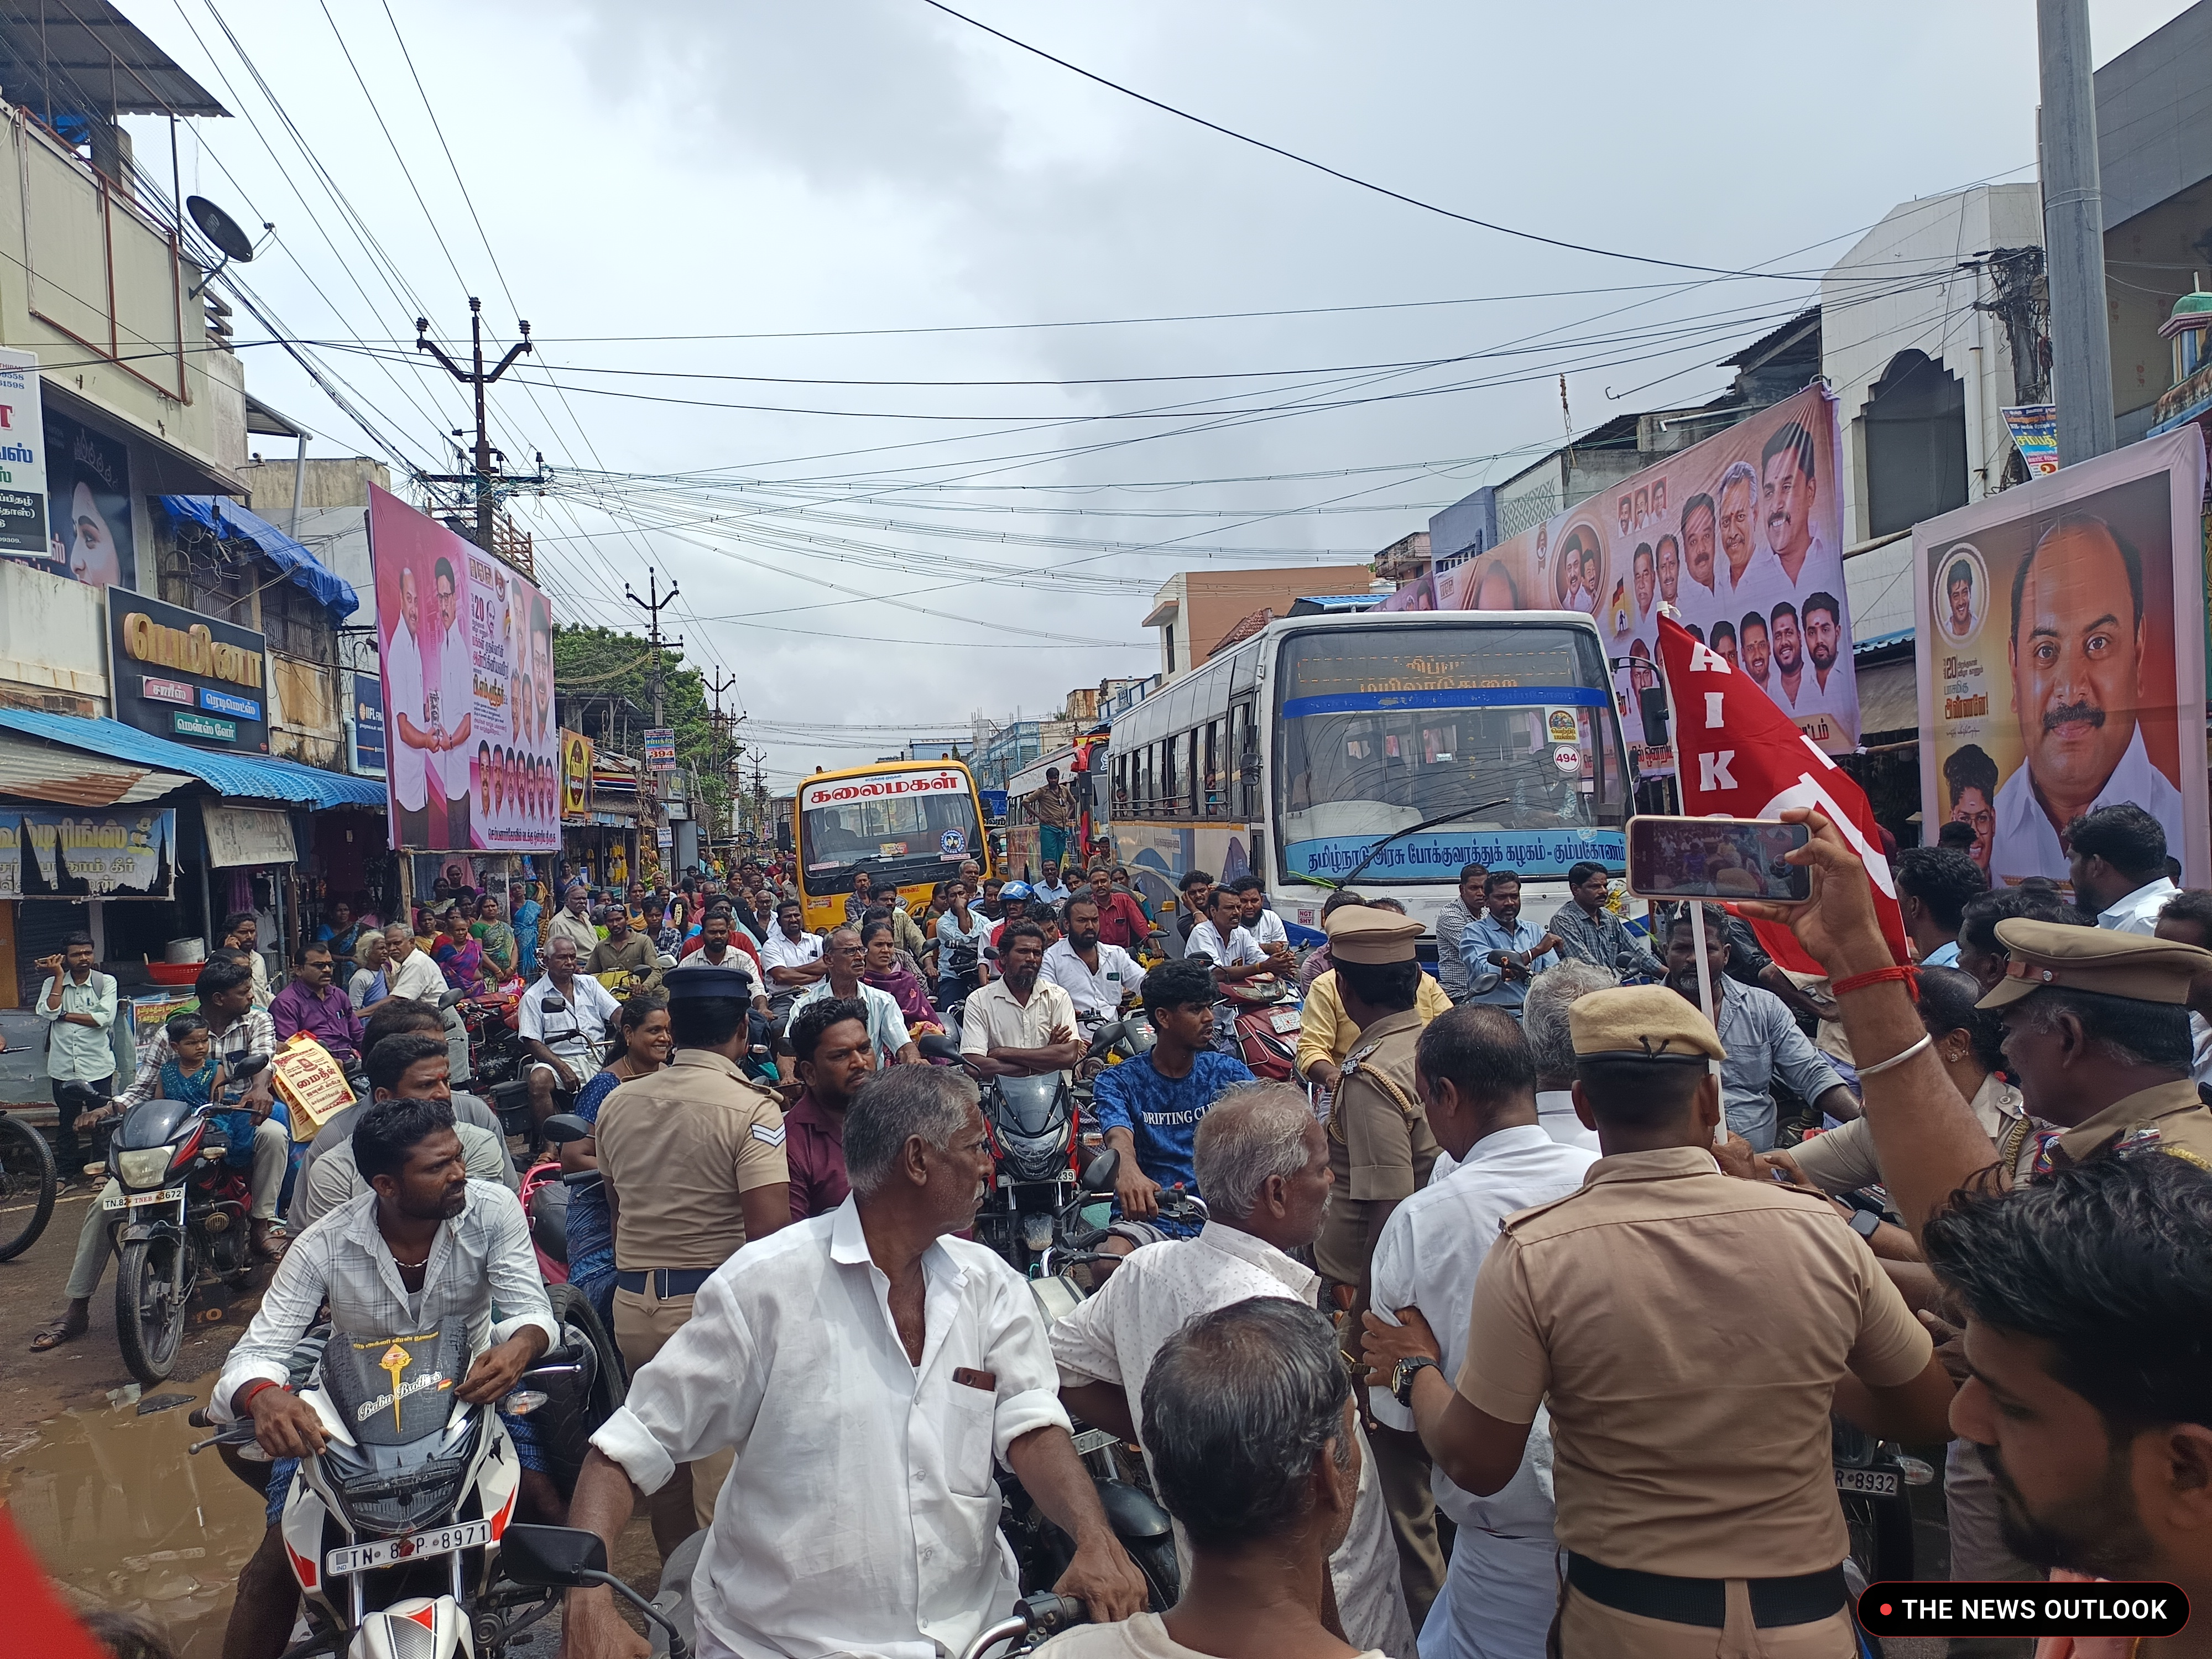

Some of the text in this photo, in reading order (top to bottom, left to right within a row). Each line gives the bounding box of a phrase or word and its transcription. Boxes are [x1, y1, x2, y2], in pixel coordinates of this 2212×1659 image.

[475, 594, 484, 622] 20
[124, 612, 263, 688] பெமினா
[1947, 656, 1957, 680] 20
[366, 706, 375, 720] IIFL
[1689, 641, 1738, 818] AIK
[1556, 753, 1577, 763] 494
[811, 772, 958, 804] கலைமகள்
[1308, 843, 1370, 875] தமிழ்நாடு
[1373, 846, 1405, 868] அரசு
[1506, 836, 1546, 868] கழகம்
[1554, 836, 1626, 864] கும்பகோணம்
[296, 1066, 337, 1089] மைதீன்
[1141, 1101, 1220, 1125] DRIFTING CLU
[366, 1339, 390, 1348] அக்னி
[358, 1371, 442, 1421] Babu Brothers
[1855, 1472, 1895, 1493] 8932
[351, 1550, 373, 1567] TN
[442, 1524, 486, 1548] 8971
